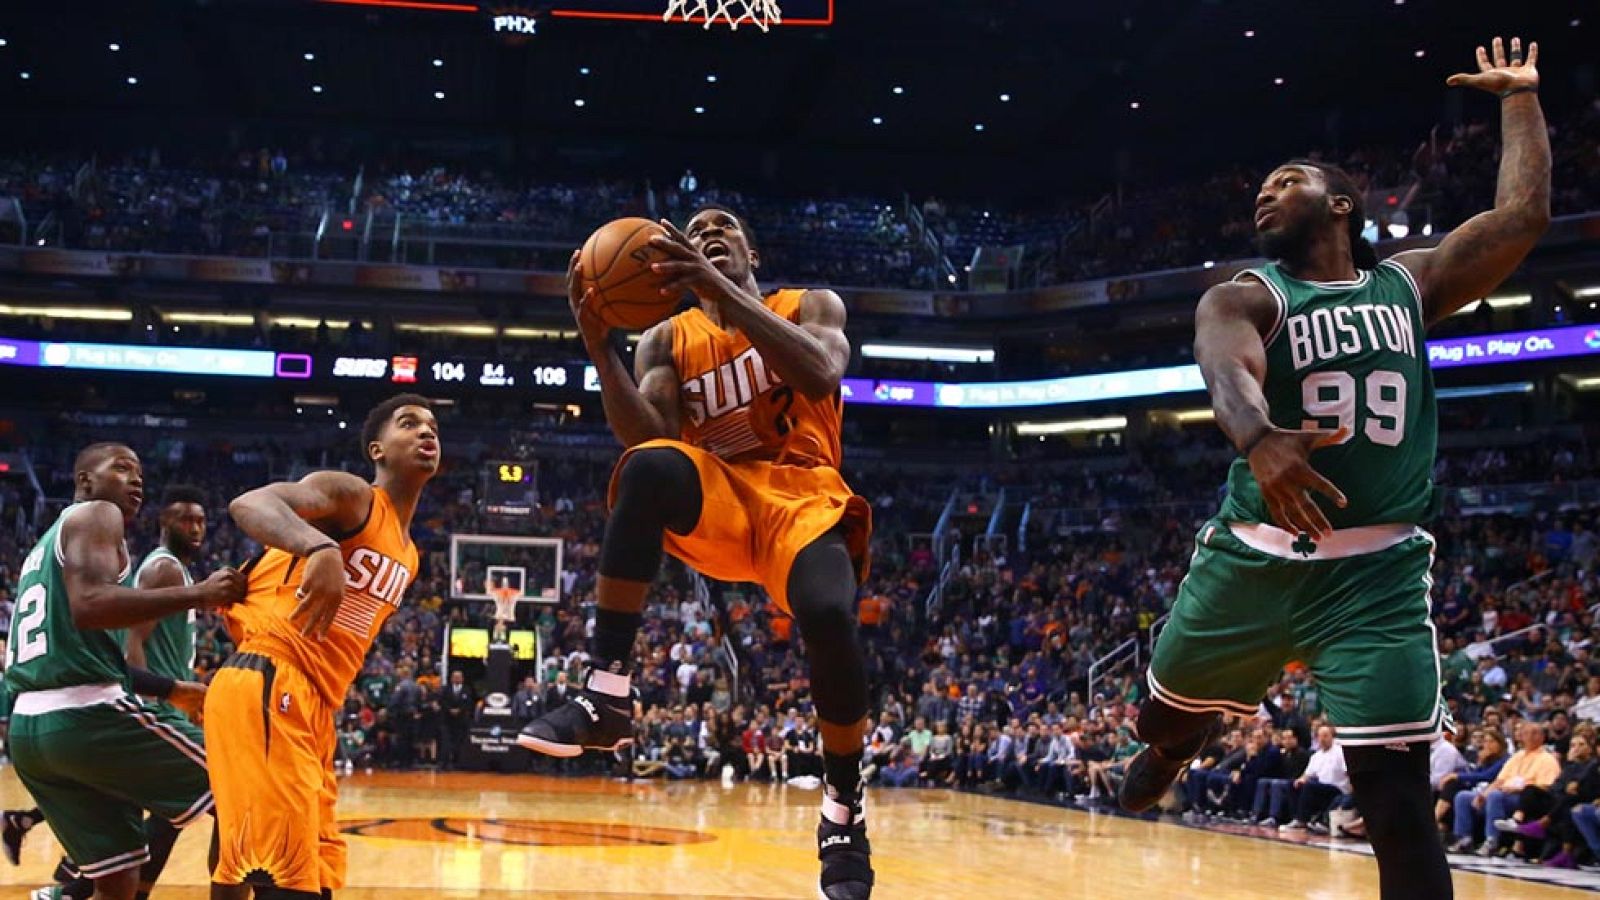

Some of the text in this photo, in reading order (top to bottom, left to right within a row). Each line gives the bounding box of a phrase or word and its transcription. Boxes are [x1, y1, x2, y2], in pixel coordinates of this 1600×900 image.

[494, 15, 536, 34] PHX
[1287, 303, 1416, 370] BOSTON
[1429, 345, 1463, 361] Plug
[1487, 340, 1522, 355] Play
[1524, 336, 1555, 352] On.
[432, 362, 466, 381] 104
[681, 347, 783, 429] SUN
[771, 386, 798, 437] 2
[1302, 370, 1407, 447] 99
